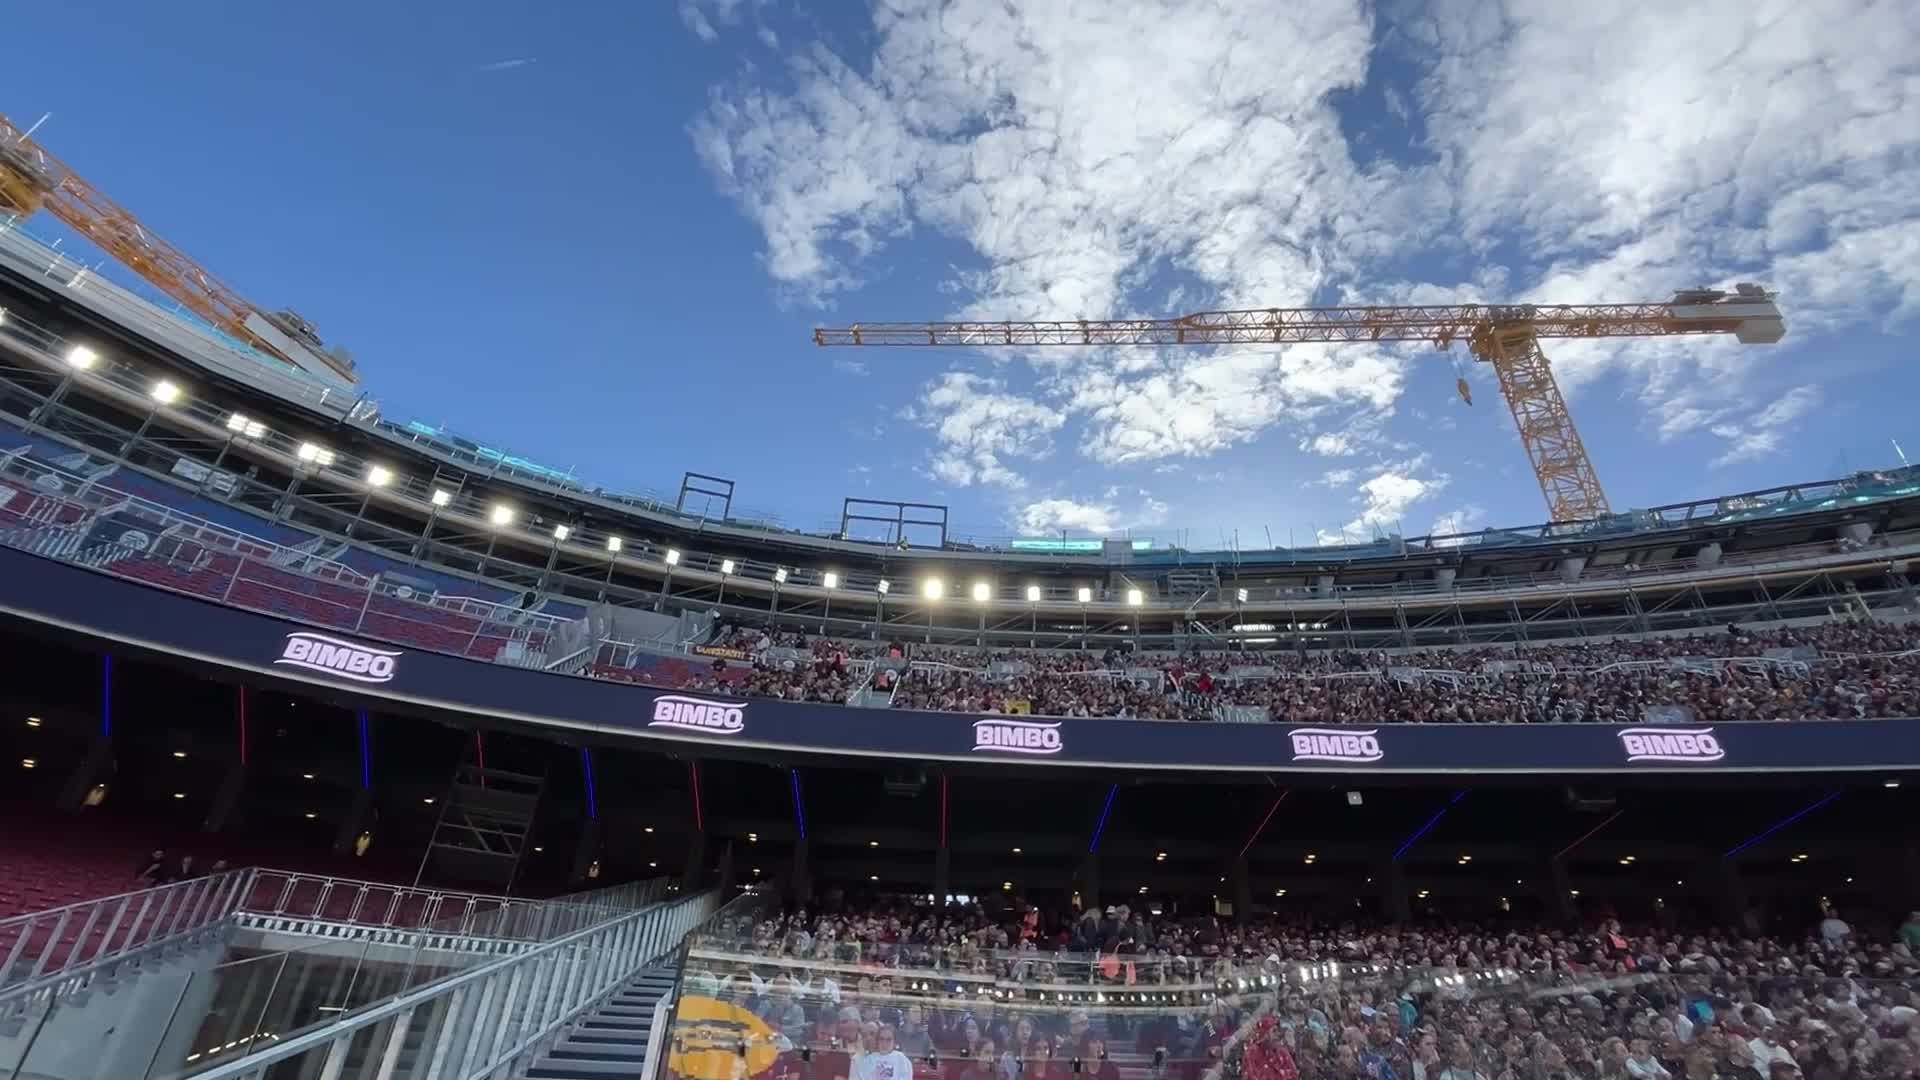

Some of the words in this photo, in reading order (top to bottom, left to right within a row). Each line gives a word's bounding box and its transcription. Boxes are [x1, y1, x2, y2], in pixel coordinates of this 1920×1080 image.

[283, 637, 394, 677] BIMBO
[653, 701, 743, 728] BIMBO
[976, 725, 1060, 748] BIMBO
[1292, 735, 1380, 756] BIMBO
[1622, 734, 1720, 755] BIMBO
